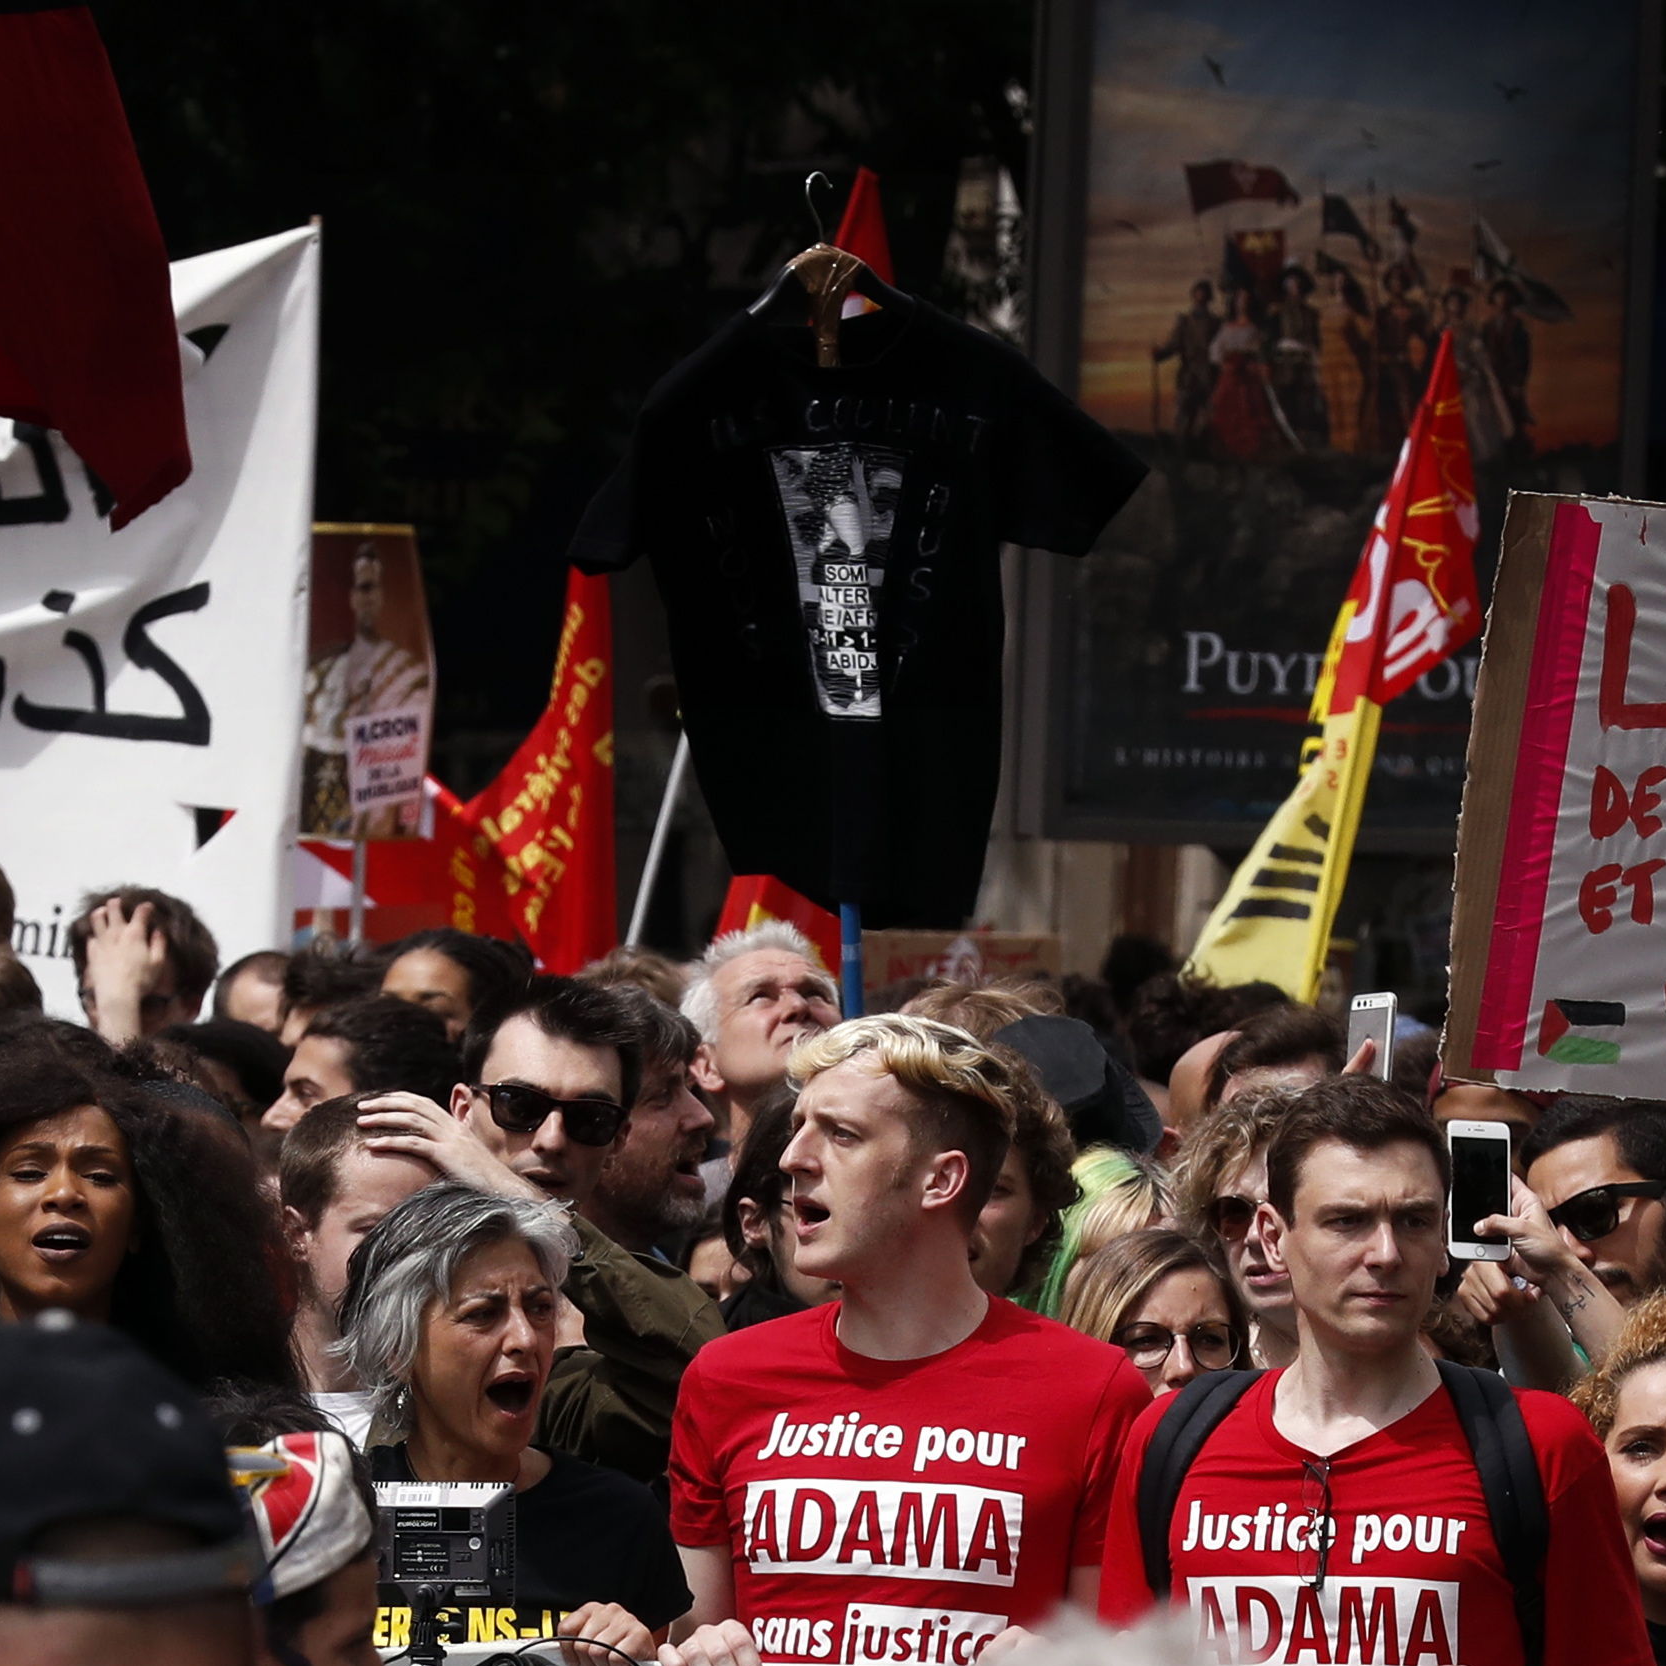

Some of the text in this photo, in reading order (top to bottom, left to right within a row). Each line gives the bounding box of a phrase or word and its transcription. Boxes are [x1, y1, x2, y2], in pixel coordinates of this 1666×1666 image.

[1578, 858, 1665, 936] ET
[757, 1412, 1028, 1472] Justice pour
[748, 1488, 1015, 1577] ADAMA
[1183, 1500, 1466, 1564] Justice pour
[752, 1617, 834, 1658] sans
[1196, 1586, 1453, 1666] ADAMA
